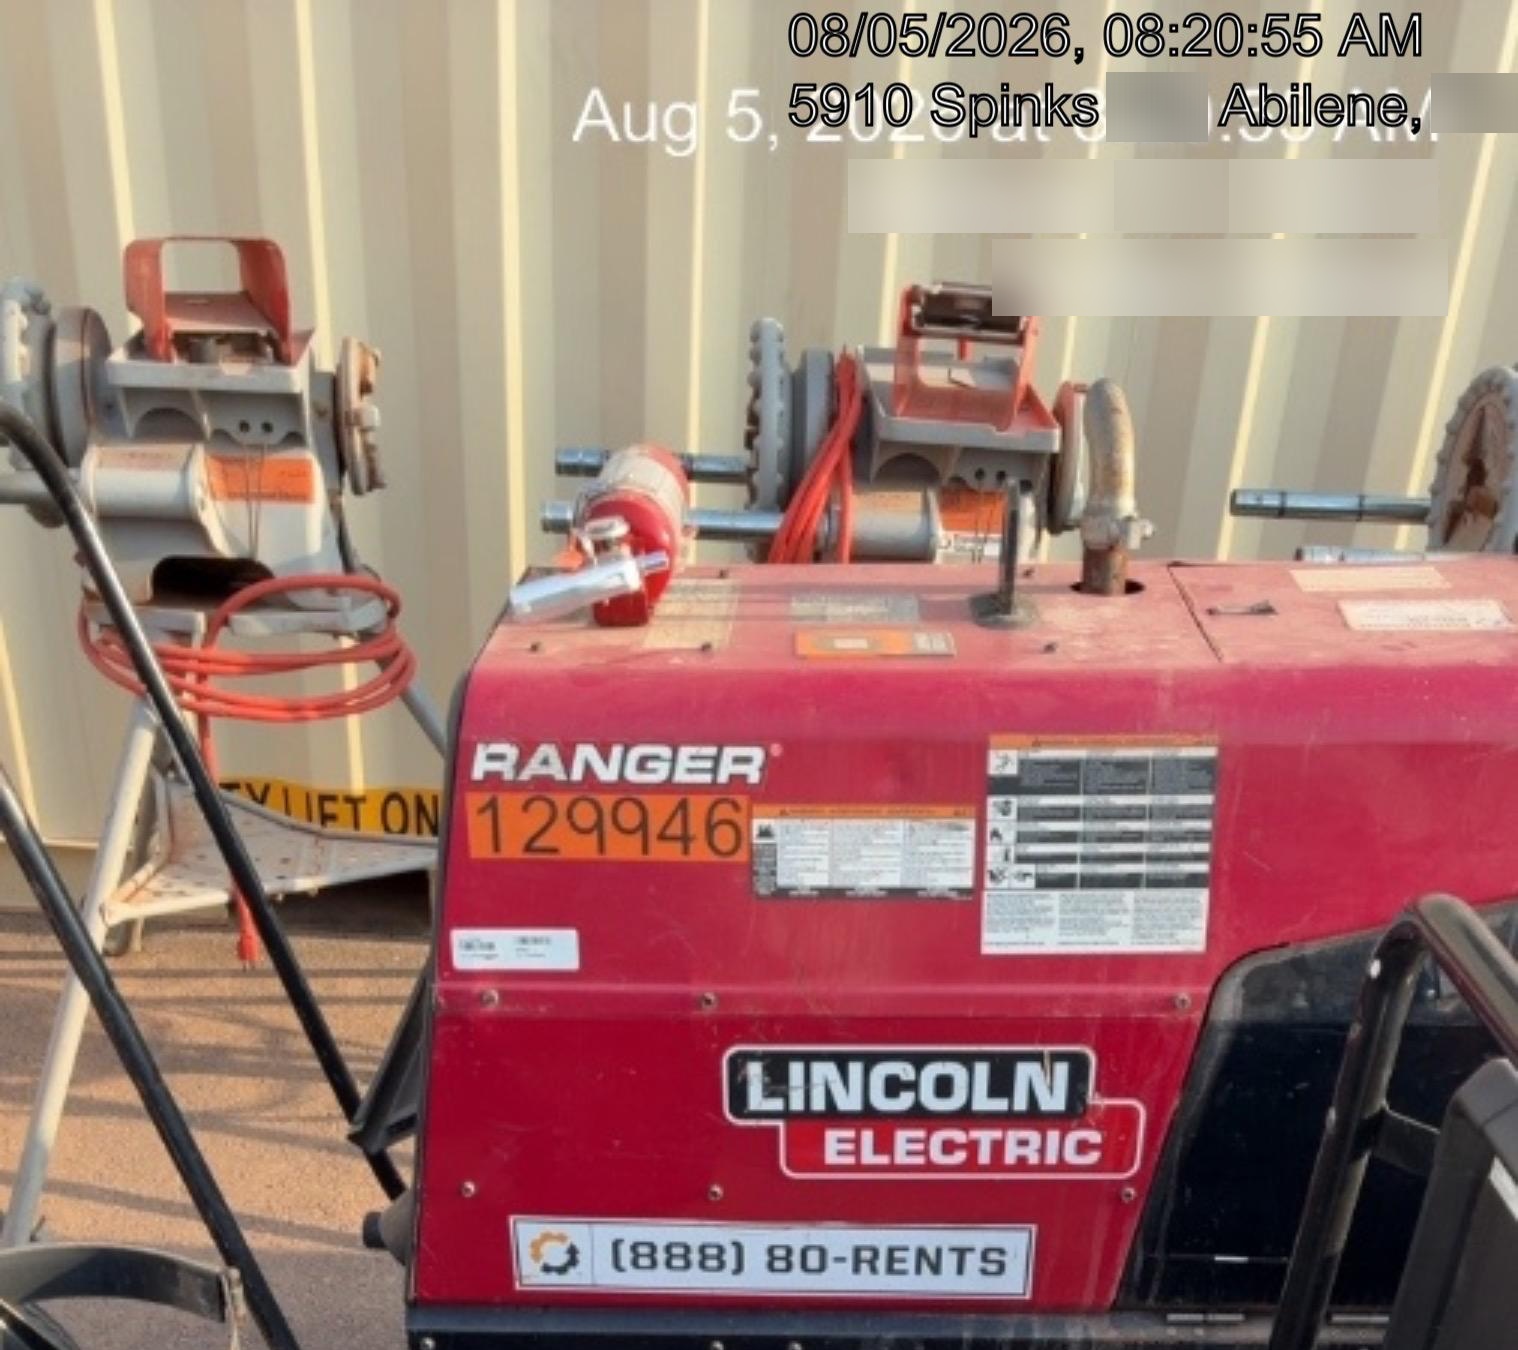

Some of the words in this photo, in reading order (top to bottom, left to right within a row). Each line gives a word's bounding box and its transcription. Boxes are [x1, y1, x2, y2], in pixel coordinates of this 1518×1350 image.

[470, 743, 767, 785] RANGER
[476, 794, 743, 858] 129946
[745, 1060, 1071, 1113] LINCOLN
[823, 1128, 1103, 1166] ELECTRIC
[611, 1238, 746, 1275] (888)
[765, 1244, 1009, 1277] 80-RENTS
